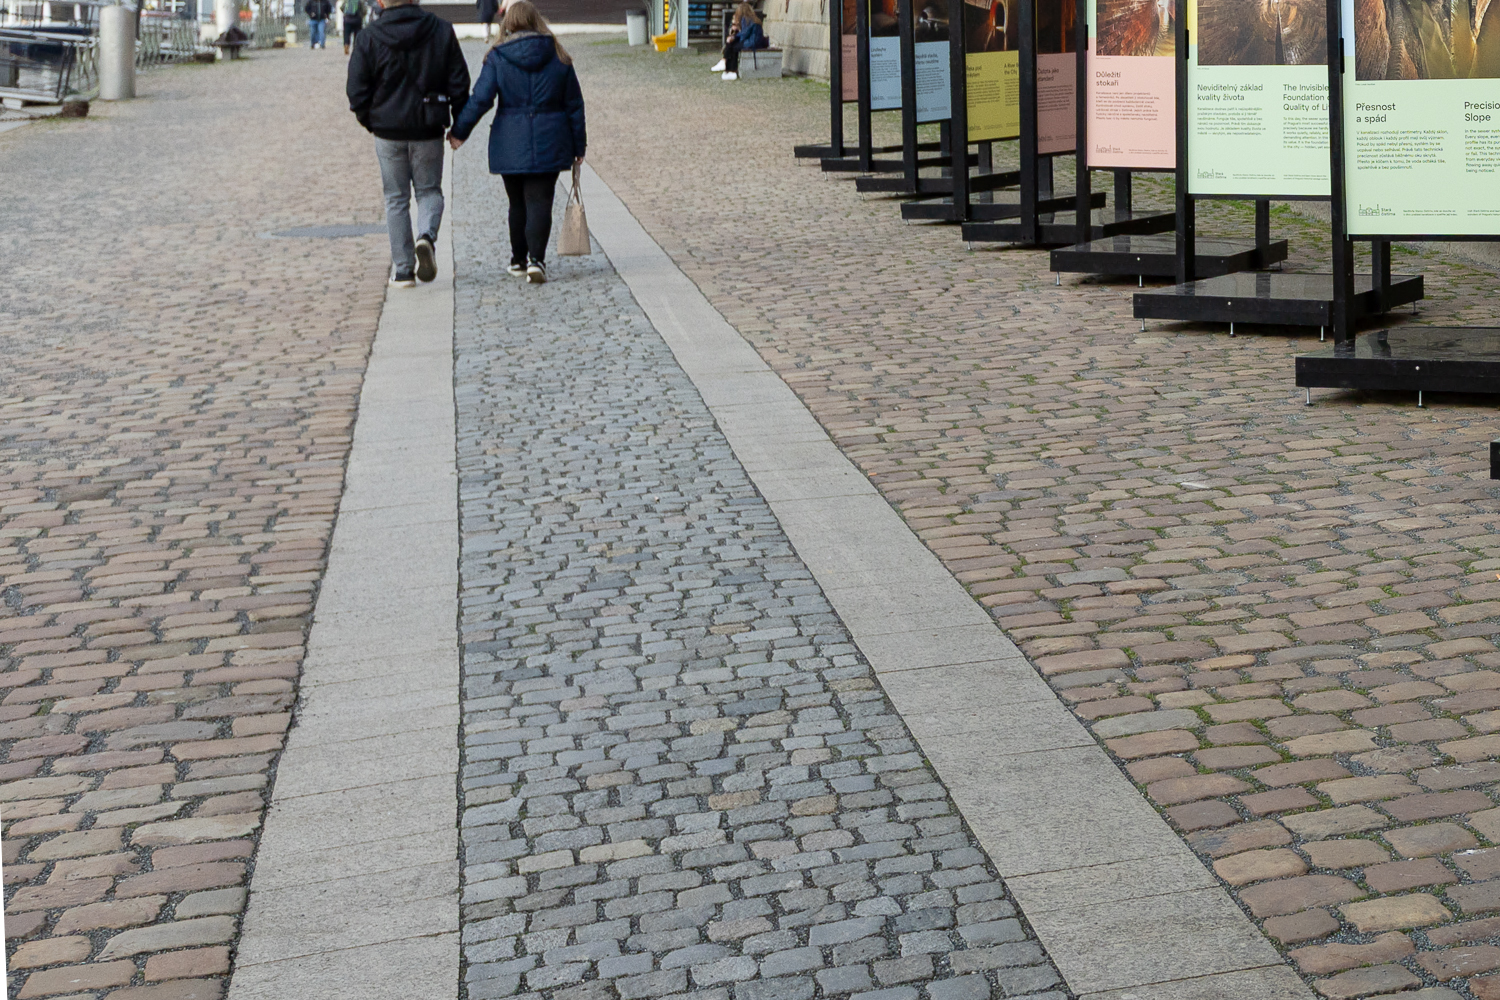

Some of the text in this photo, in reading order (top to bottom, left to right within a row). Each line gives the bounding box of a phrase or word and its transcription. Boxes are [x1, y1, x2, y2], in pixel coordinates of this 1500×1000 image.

[1197, 84, 1238, 92] Neviditelný
[1198, 94, 1220, 102] kvality
[1356, 103, 1396, 111] Přesnost
[1365, 114, 1386, 124] spád
[1465, 113, 1491, 123] Slope
